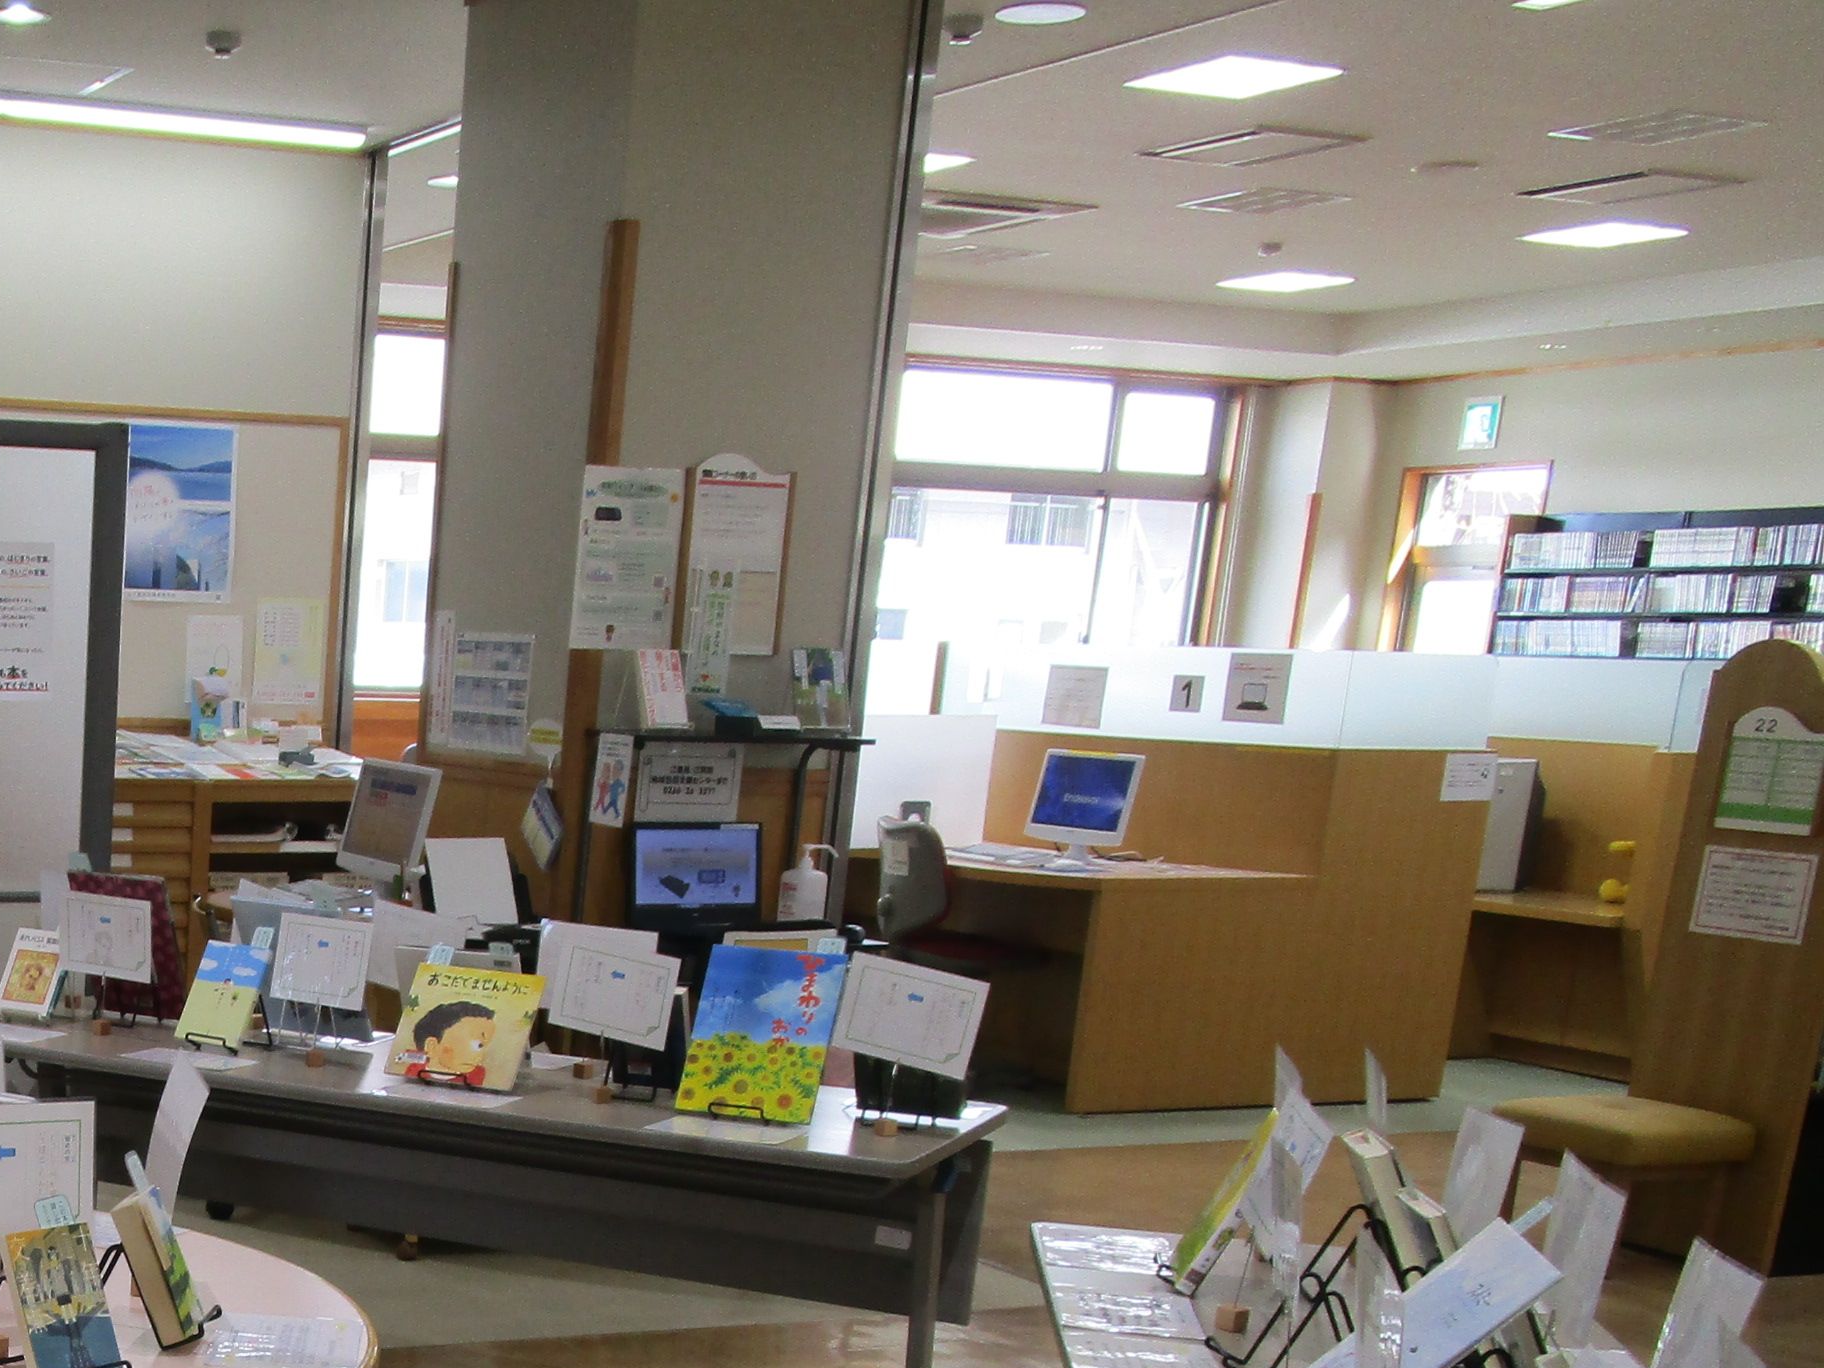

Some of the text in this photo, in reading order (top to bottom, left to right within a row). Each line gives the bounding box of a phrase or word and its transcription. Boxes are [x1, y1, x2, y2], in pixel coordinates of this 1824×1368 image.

[1181, 680, 1193, 709] 1
[1754, 718, 1779, 733] 22
[427, 970, 531, 996] おこだでませんように
[795, 953, 826, 1037] ひまわりの
